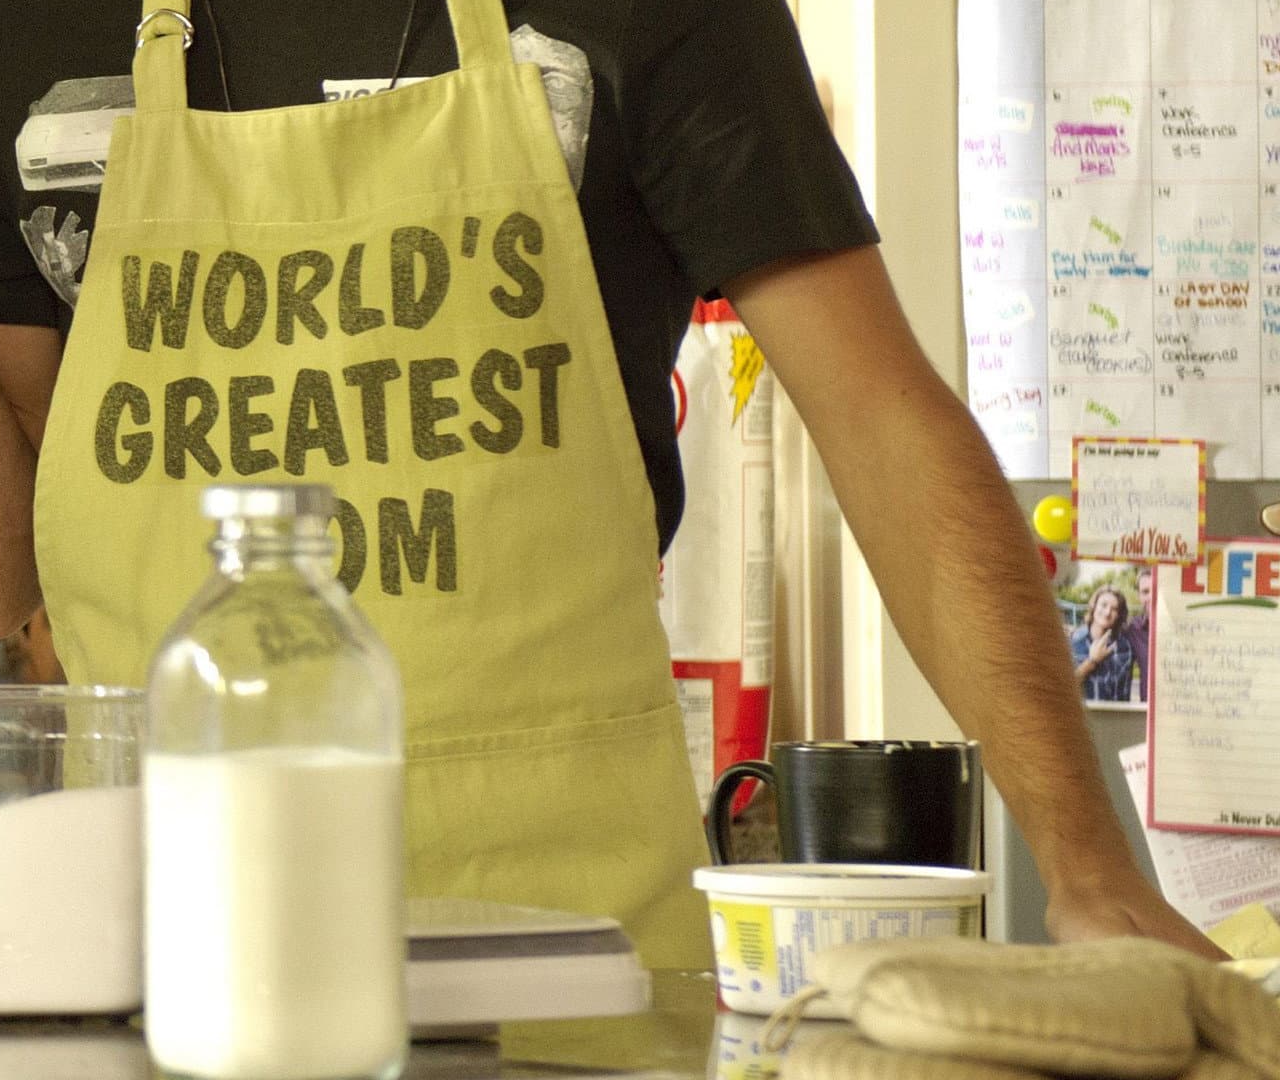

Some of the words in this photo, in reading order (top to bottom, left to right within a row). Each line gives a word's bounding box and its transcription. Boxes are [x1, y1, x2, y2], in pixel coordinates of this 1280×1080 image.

[121, 211, 545, 353] WORLD'S
[94, 342, 573, 484] GREATEST
[1120, 526, 1145, 557] Told
[1148, 525, 1171, 557] You
[1181, 549, 1280, 597] LIFE
[1231, 810, 1262, 825] Never
